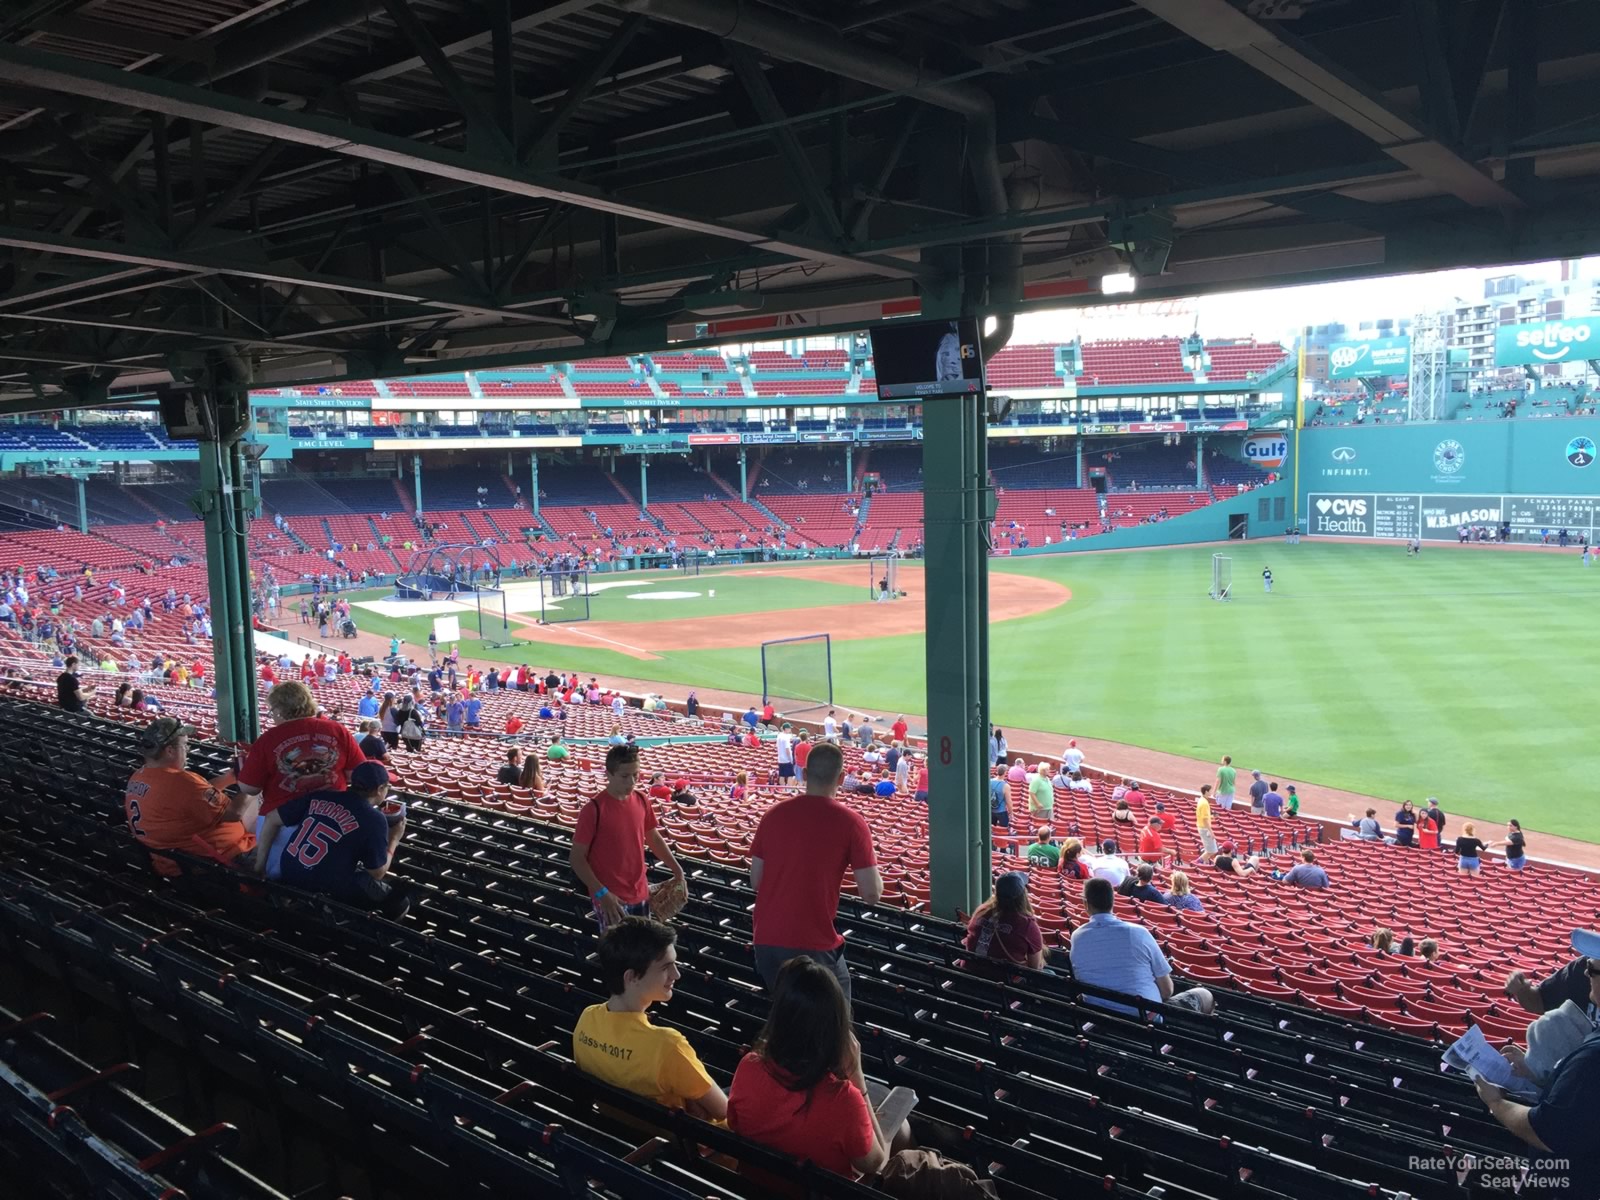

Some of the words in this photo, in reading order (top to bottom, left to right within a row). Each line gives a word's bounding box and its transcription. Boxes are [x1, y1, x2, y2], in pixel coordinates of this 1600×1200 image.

[1245, 442, 1286, 457] Gulf
[1446, 441, 1459, 450] SOX
[1322, 468, 1369, 476] INFINITI
[1332, 498, 1367, 516] CVS
[1317, 516, 1367, 533] Health
[940, 735, 952, 766] 8
[130, 800, 146, 836] 2
[308, 799, 360, 835] PEDROIA
[286, 816, 342, 867] 15
[578, 1030, 599, 1049] Class
[599, 1042, 607, 1053] of
[609, 1044, 633, 1061] 2017
